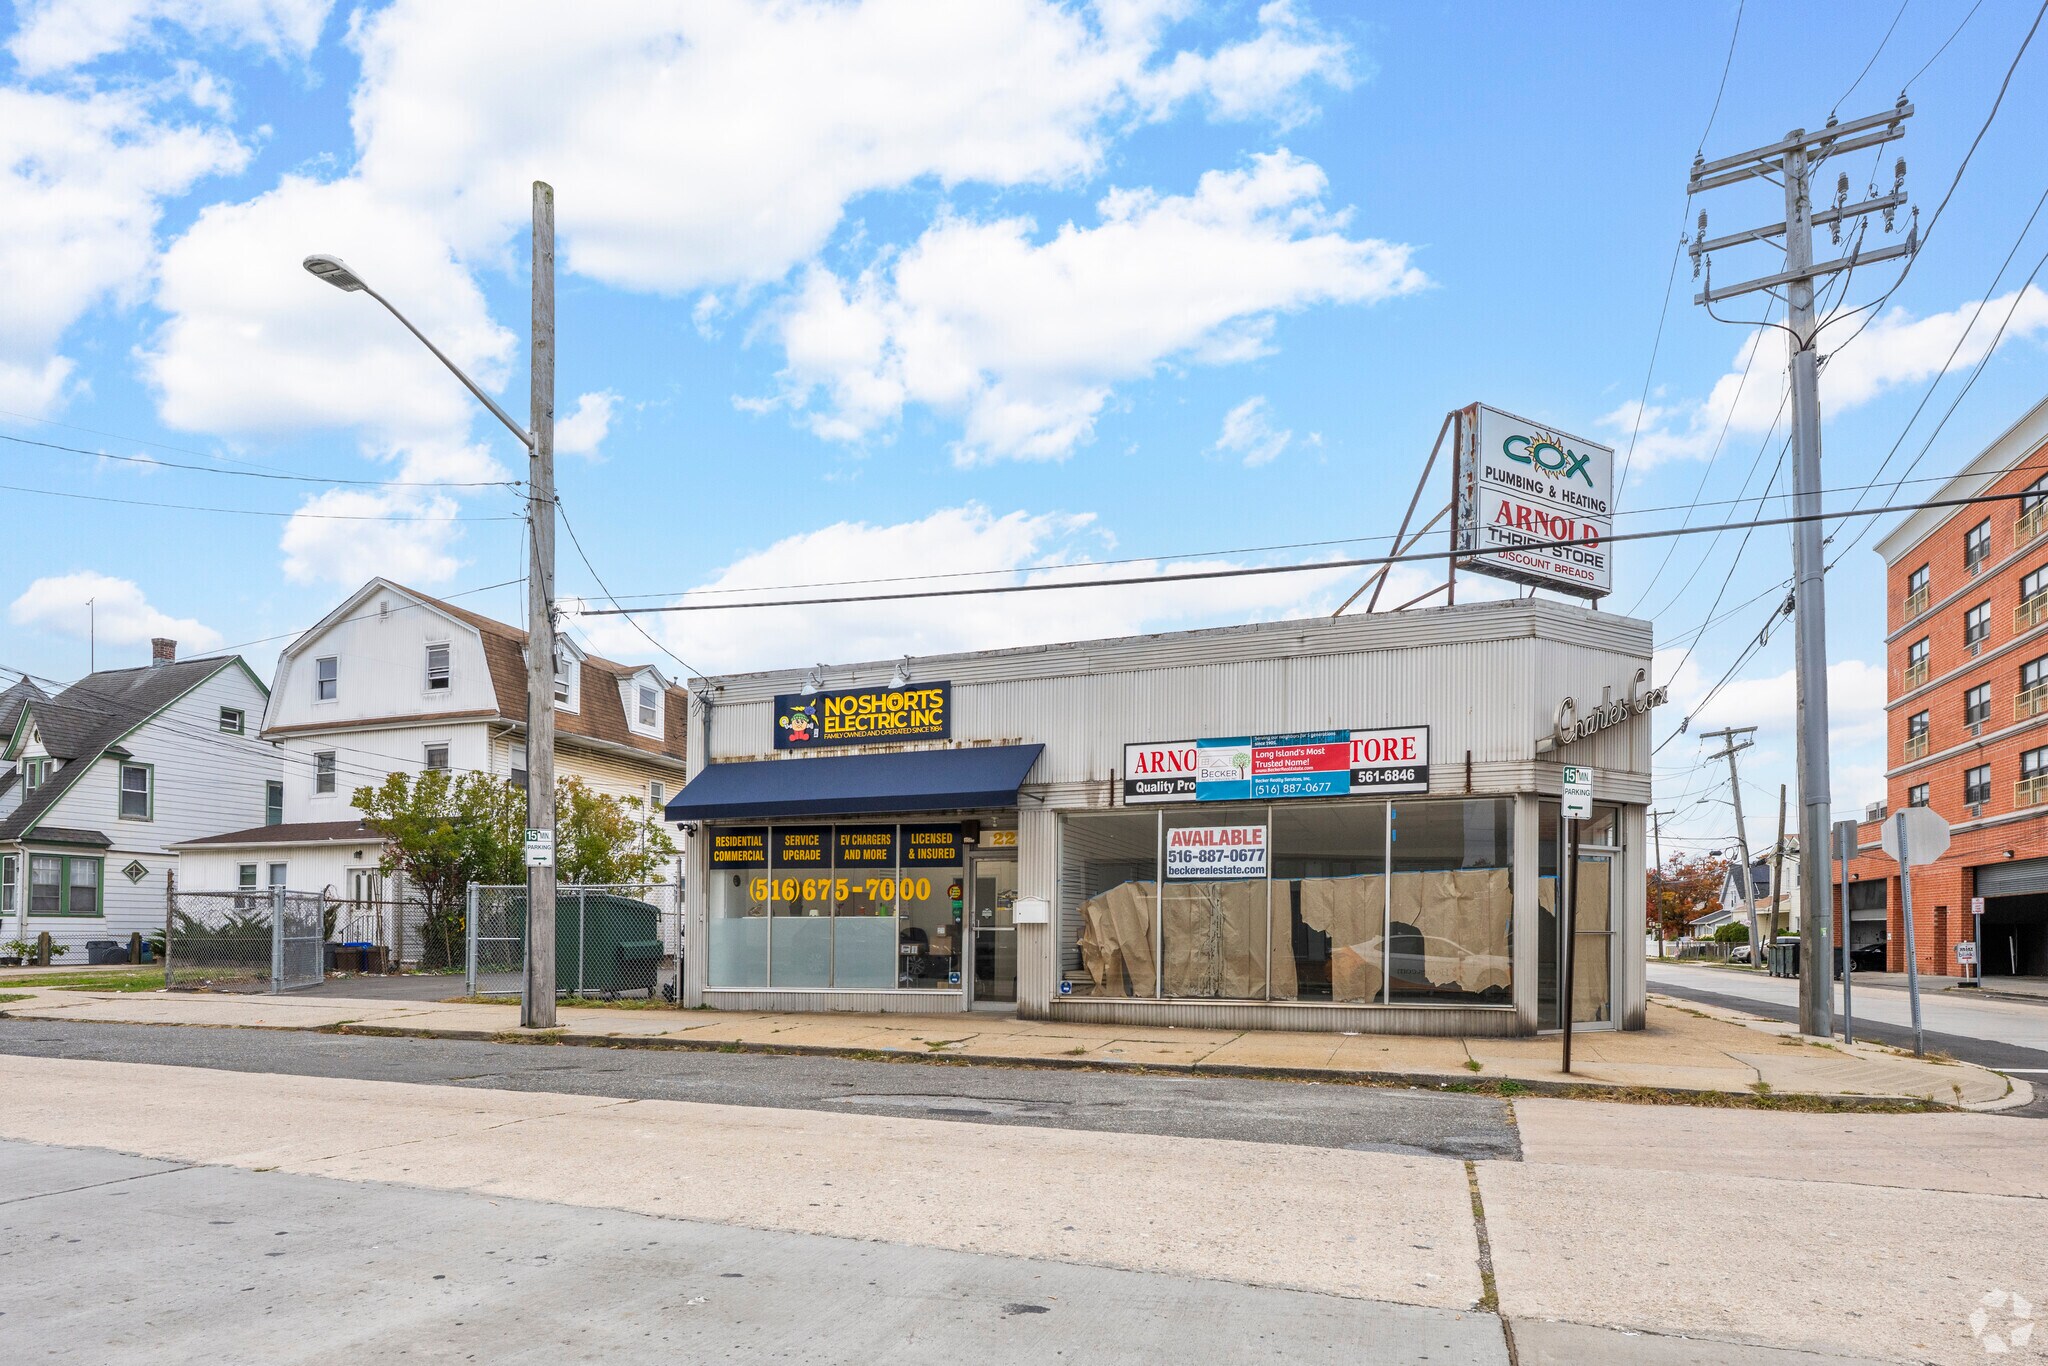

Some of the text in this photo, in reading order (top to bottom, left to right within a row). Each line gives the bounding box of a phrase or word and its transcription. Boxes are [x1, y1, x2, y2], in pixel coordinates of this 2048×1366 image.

[1503, 434, 1593, 487] COX
[1485, 465, 1607, 513] PLUMBING & HEATING
[1494, 500, 1599, 549] ARNOLD
[1552, 544, 1604, 569] STORE
[1497, 550, 1595, 581] DISCOUNT BREADS
[1555, 667, 1669, 746] Charles Cox
[824, 708, 943, 733] ELECTRIC INC
[823, 732, 844, 740] FAMILY
[880, 727, 912, 736] OPERATED
[912, 726, 929, 734] SINCE
[1255, 747, 1326, 760] Long Island's Most
[1255, 758, 1310, 768] Trusted Name!
[1358, 769, 1415, 783] 561-6846
[1565, 769, 1576, 782] 15
[1136, 780, 1196, 794] Quality Pro
[1255, 782, 1331, 797] (516) 887-0677
[1564, 787, 1591, 797] PARKING
[526, 830, 537, 841] 15
[715, 836, 763, 847] RESIDENTIAL
[784, 834, 819, 846] SERVICE
[840, 833, 891, 846] EV CHARGERS
[911, 833, 953, 844] LICENSED
[993, 831, 1017, 846] 22
[1170, 828, 1263, 847] AVAILABLE
[714, 850, 765, 862] COMMERCIAL
[783, 849, 821, 861] UPGRADE
[844, 848, 887, 860] AND MORE
[908, 847, 955, 860] & INSURED
[1168, 848, 1265, 863] 516-887-0677
[1168, 865, 1265, 875] beckerealestate.com
